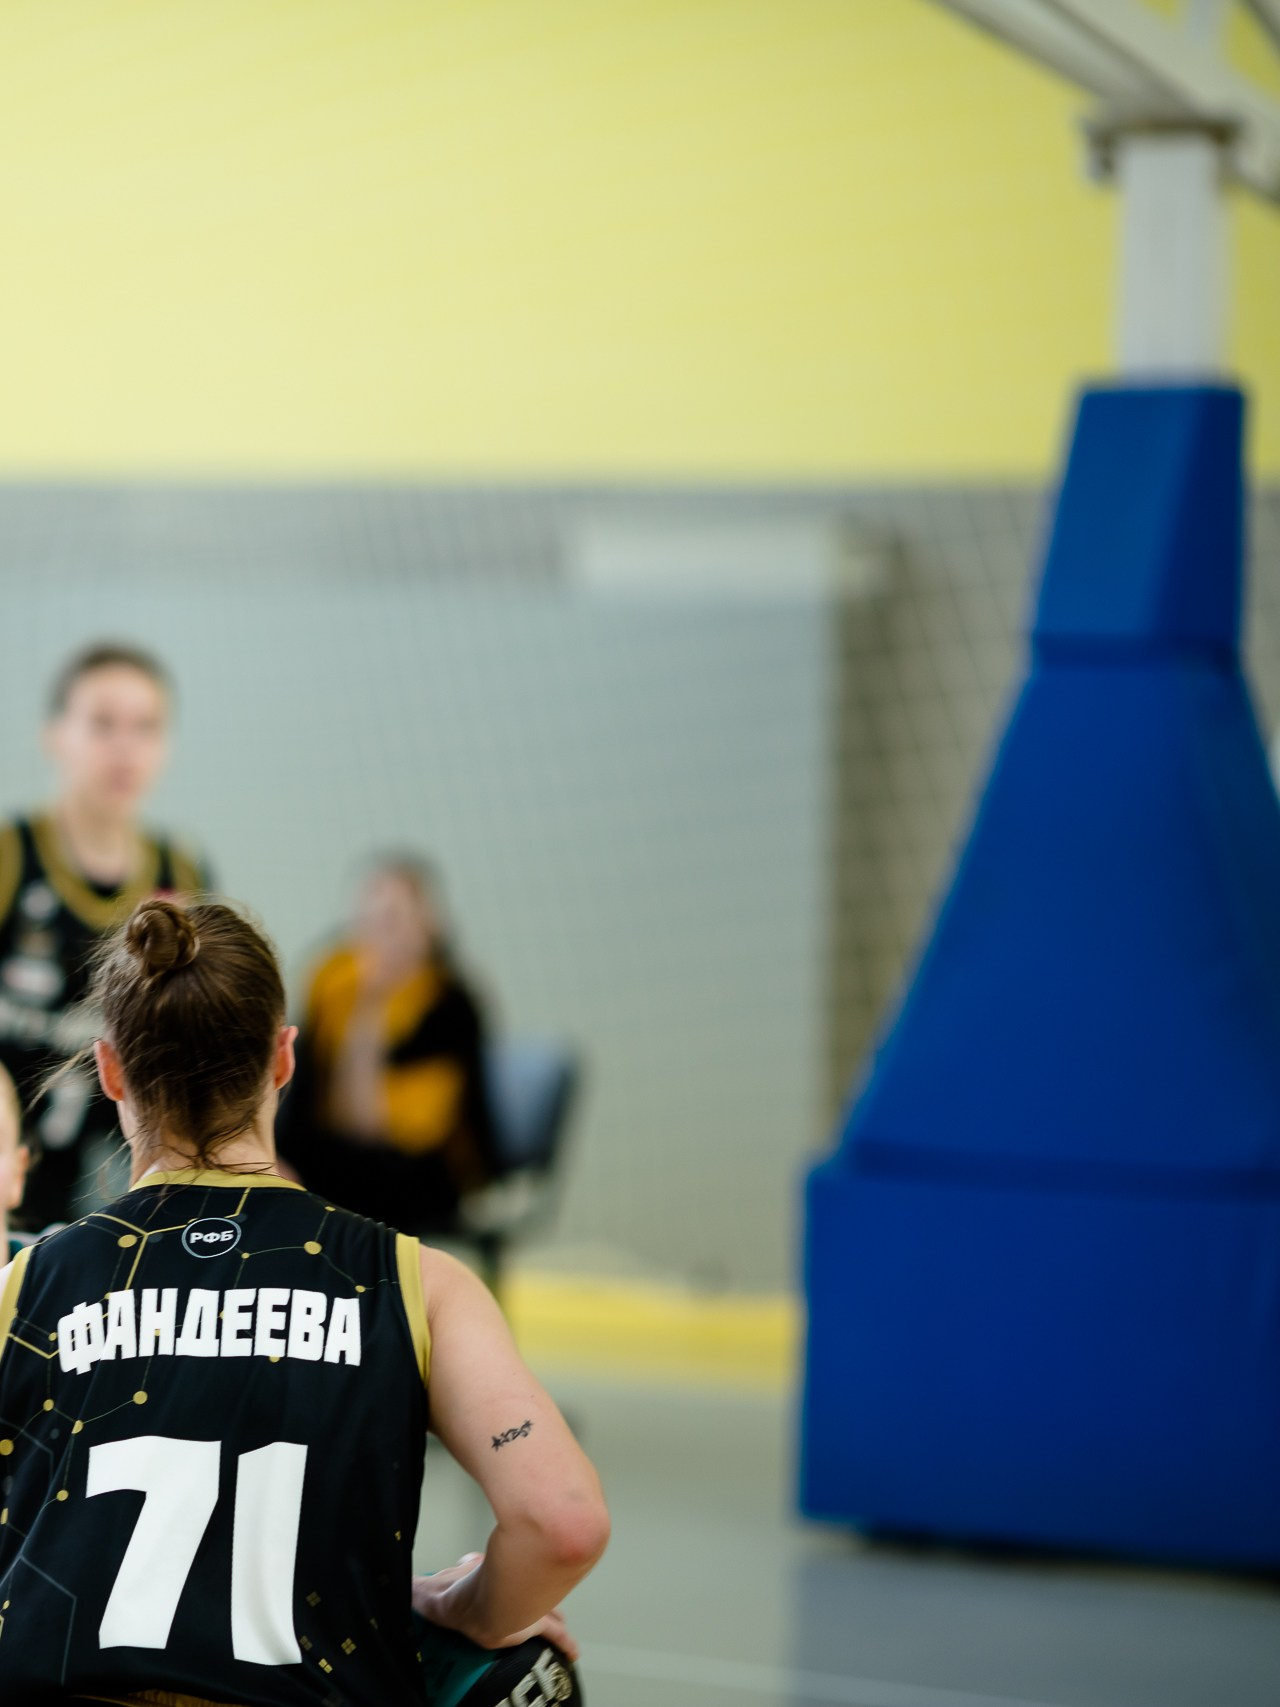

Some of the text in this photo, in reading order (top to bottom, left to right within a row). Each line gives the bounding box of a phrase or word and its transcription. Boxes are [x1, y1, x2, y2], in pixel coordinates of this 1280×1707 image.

[189, 1229, 235, 1244] РФБ
[57, 1287, 362, 1375] ФАНДЕЕВА
[85, 1435, 308, 1666] 71
